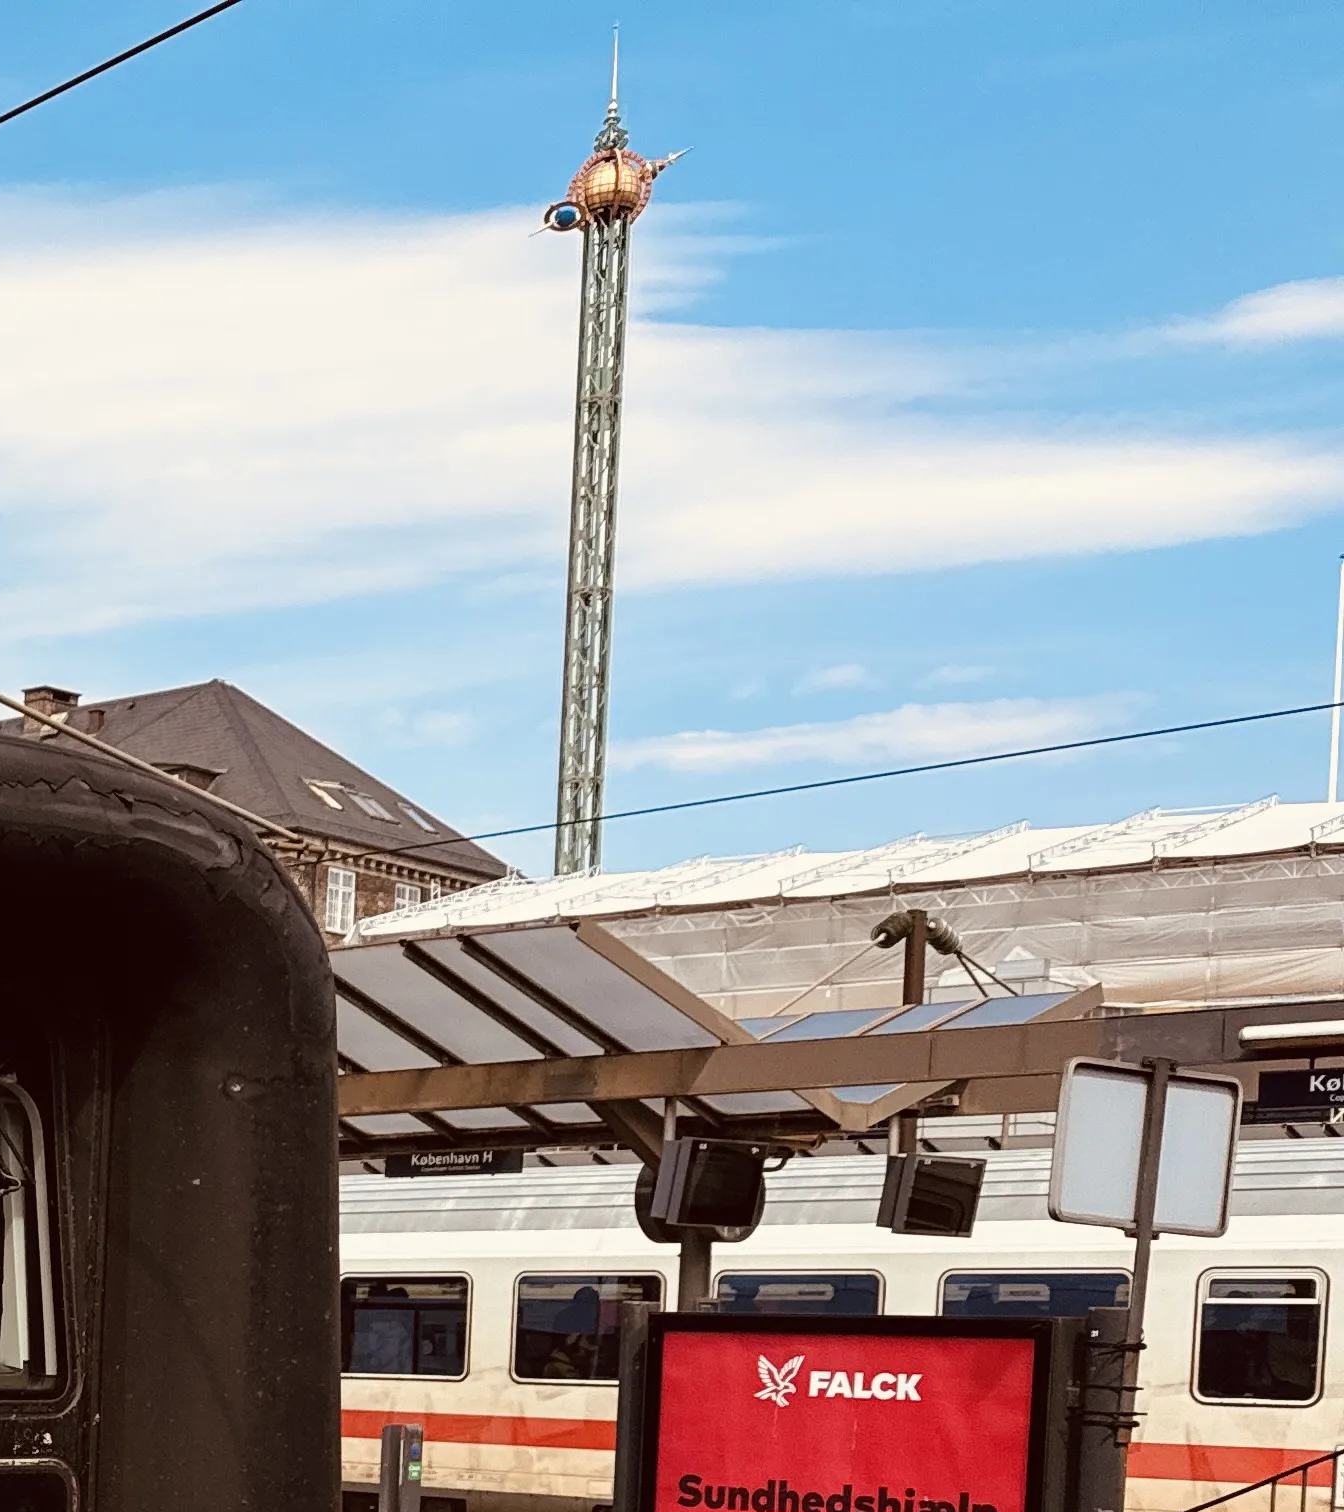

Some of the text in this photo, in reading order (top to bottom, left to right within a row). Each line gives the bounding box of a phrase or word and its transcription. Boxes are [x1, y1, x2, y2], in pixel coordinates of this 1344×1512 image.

[411, 1150, 493, 1166] København H
[808, 1371, 923, 1401] FALCK
